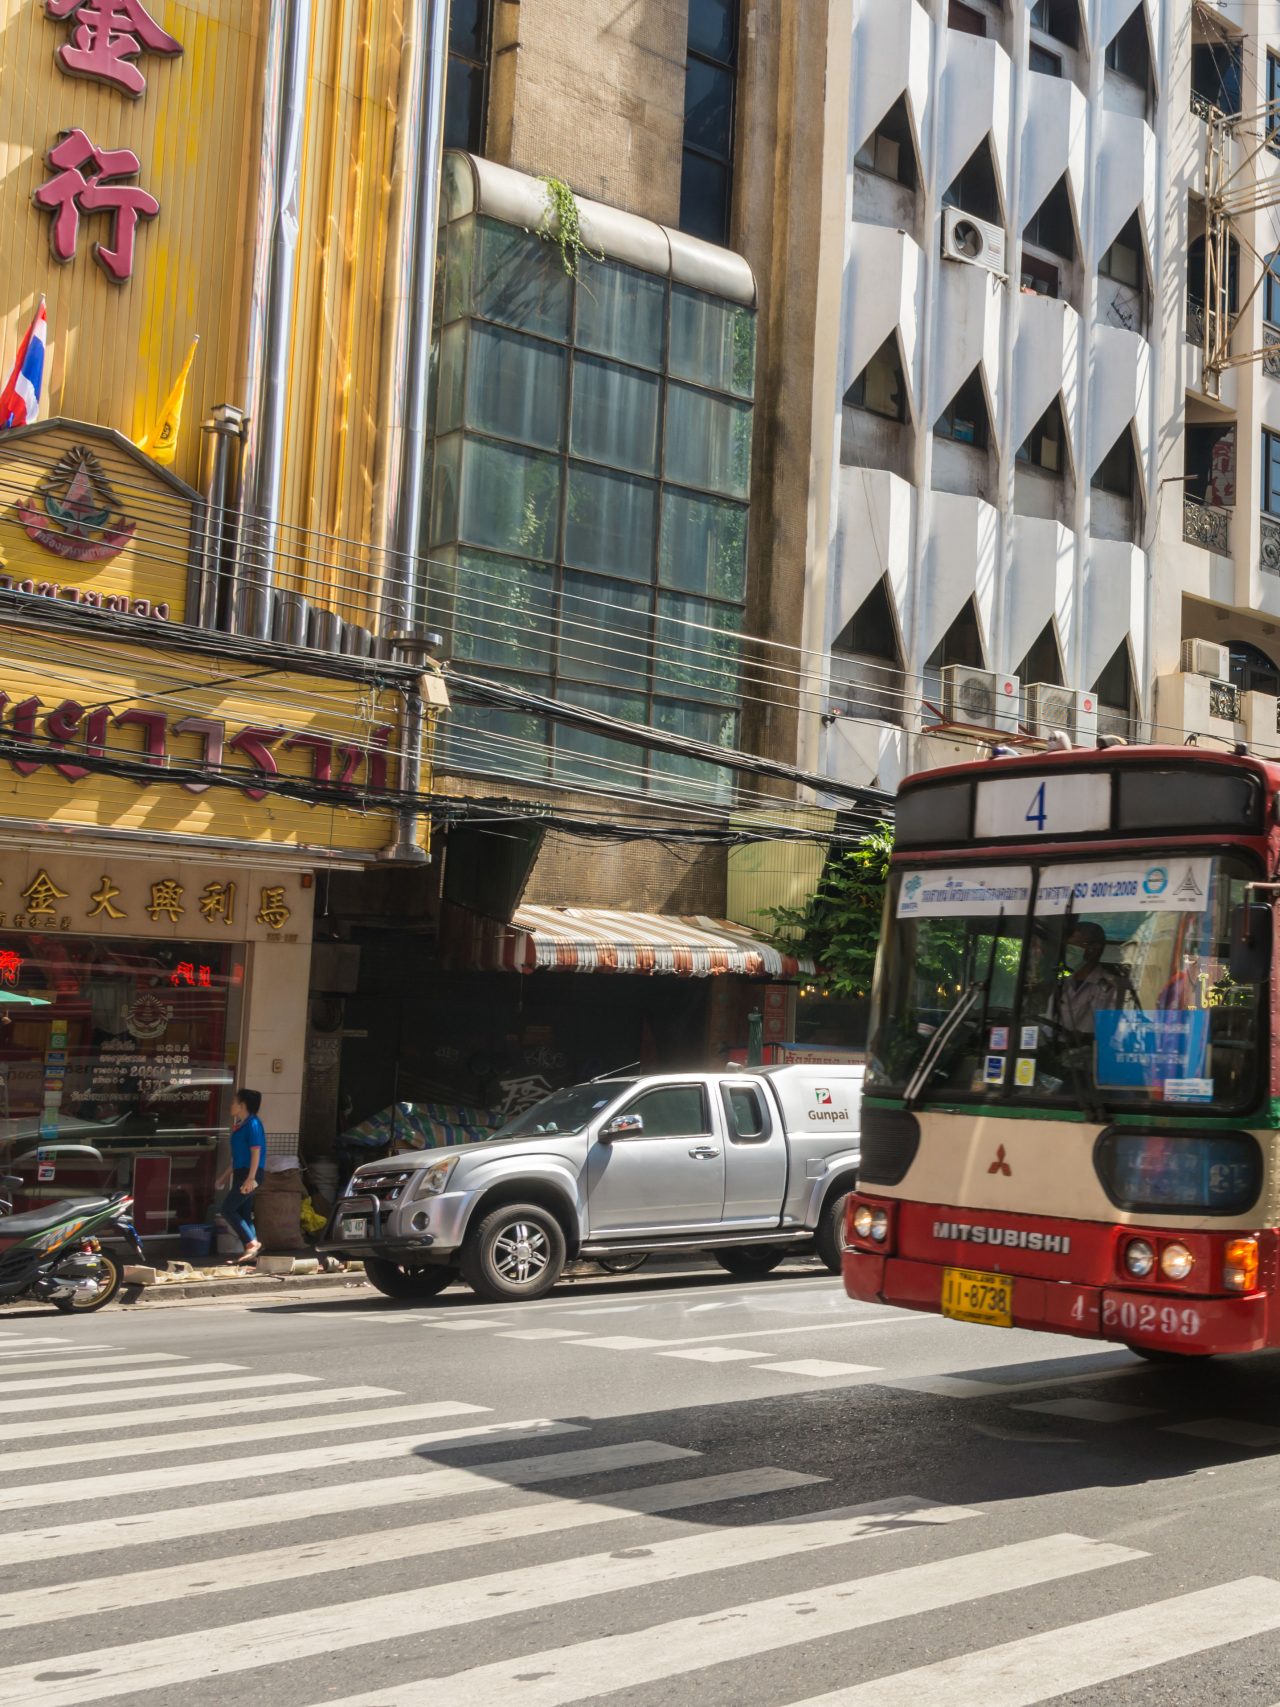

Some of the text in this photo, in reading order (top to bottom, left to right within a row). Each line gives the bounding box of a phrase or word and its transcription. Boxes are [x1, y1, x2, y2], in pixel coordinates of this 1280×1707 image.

[1025, 781, 1047, 831] 4
[808, 1109, 849, 1123] Gunpai
[933, 1222, 1070, 1254] MITSUBISHI
[1070, 1295, 1201, 1336] 4-80299
